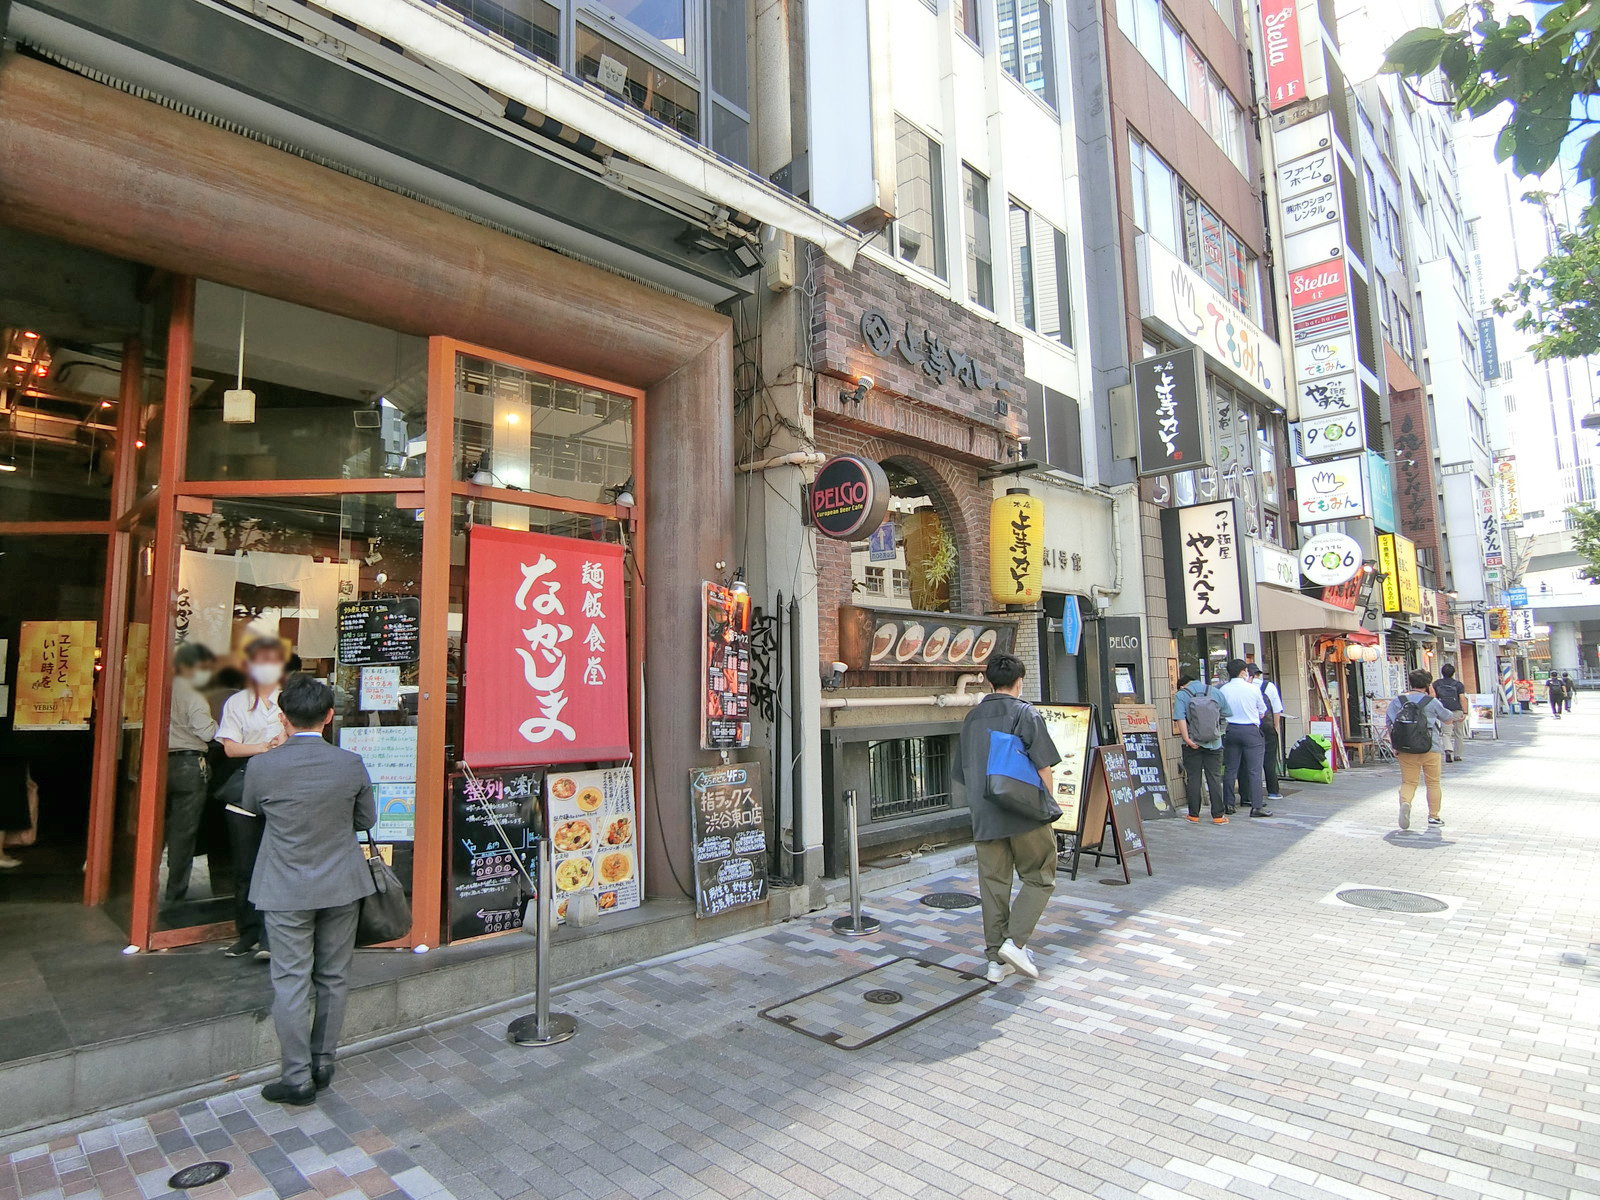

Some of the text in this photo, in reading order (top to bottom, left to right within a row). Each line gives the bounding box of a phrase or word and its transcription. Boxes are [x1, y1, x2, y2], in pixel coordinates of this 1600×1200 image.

[1265, 11, 1289, 67] Stella
[1284, 156, 1327, 180] ファイブ
[1290, 171, 1322, 188] ホーム
[1294, 205, 1326, 222] レンタル
[1294, 272, 1339, 295] Stella
[1207, 303, 1271, 390] てもみん
[1305, 360, 1346, 376] てもみん
[815, 481, 867, 511] BELGO
[1303, 496, 1358, 513] てもみん
[816, 508, 840, 518] European
[840, 506, 851, 514] Beer
[580, 560, 606, 686] 麺飯食堂
[514, 553, 577, 743] なかじま
[1109, 635, 1138, 649] BELGO
[33, 703, 58, 712] YEBISU
[1127, 714, 1150, 726] Duvel
[1126, 743, 1146, 752] DRAFT
[1128, 759, 1138, 768] 20
[701, 787, 755, 812] 指ラックス
[705, 803, 763, 834] 渋谷東口店
